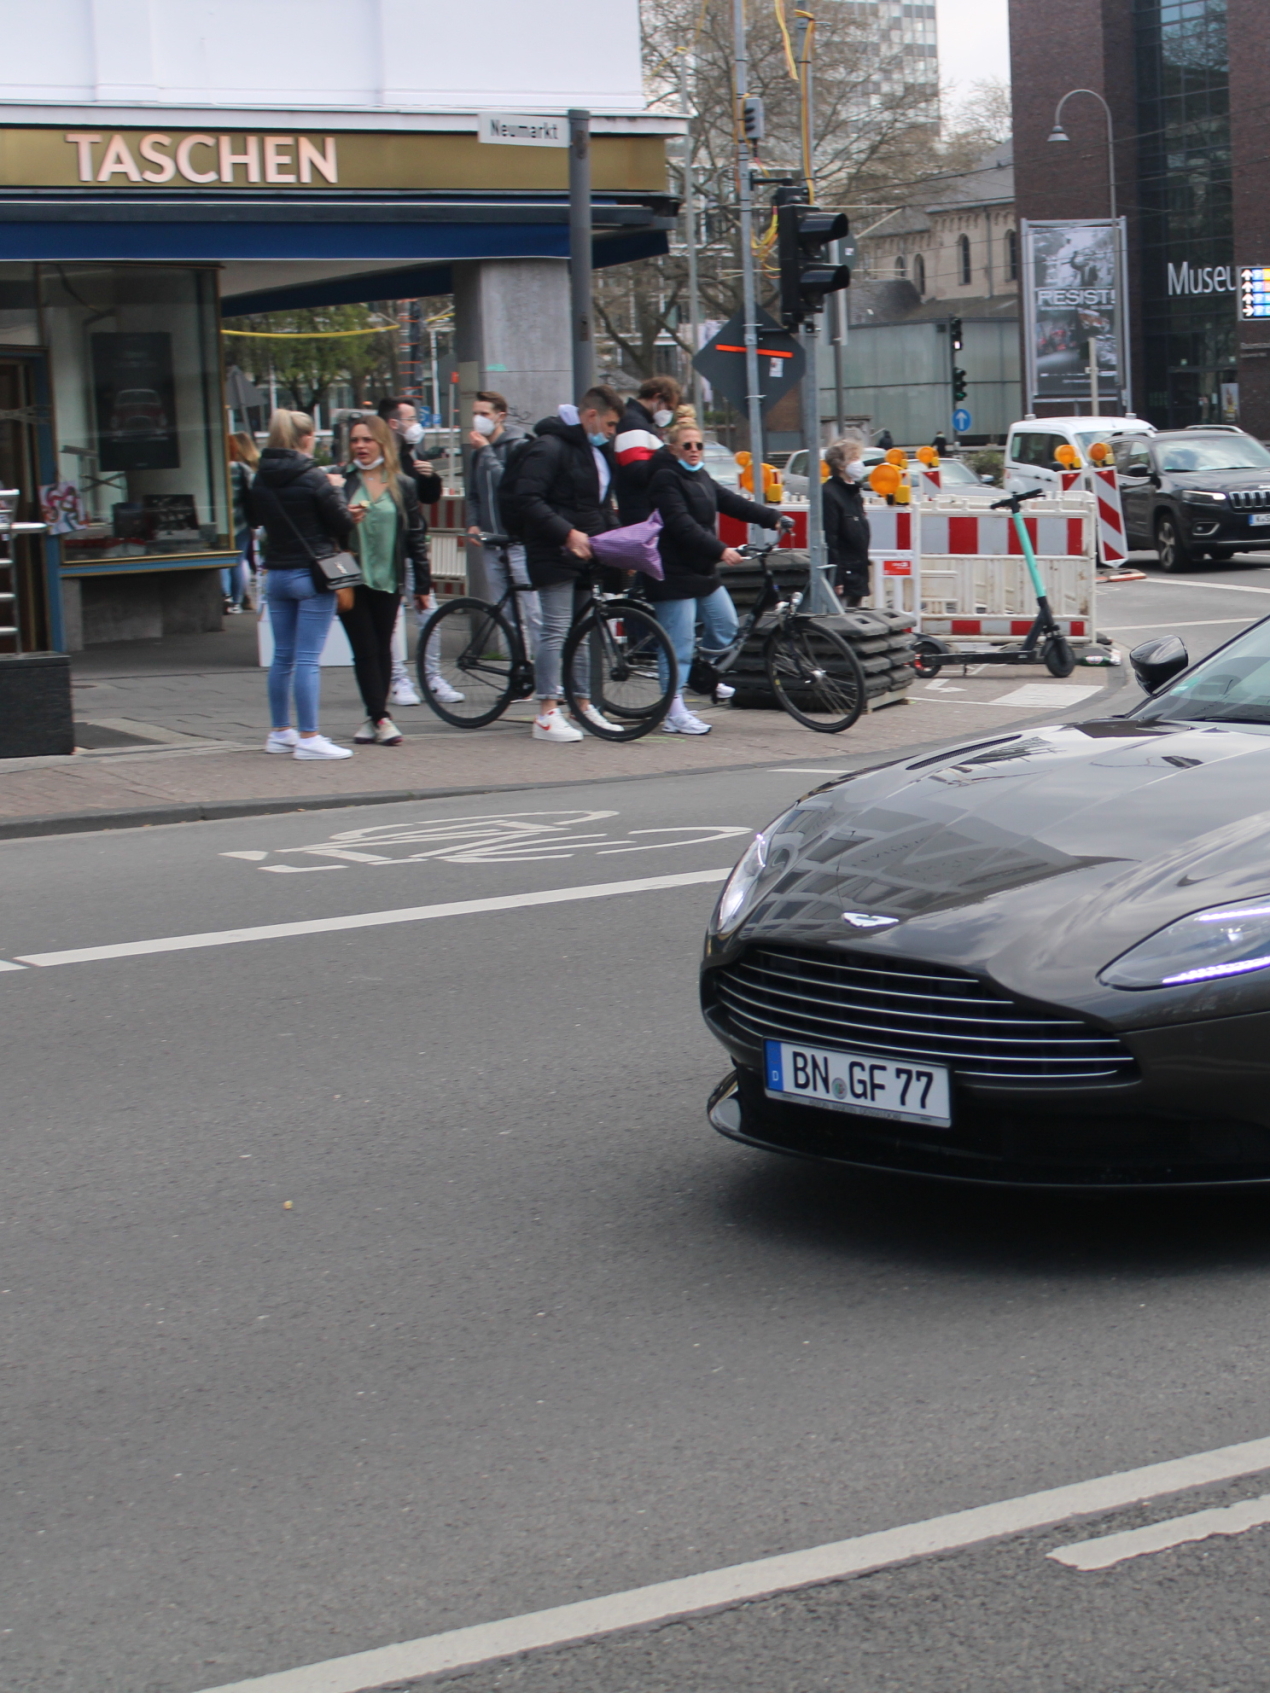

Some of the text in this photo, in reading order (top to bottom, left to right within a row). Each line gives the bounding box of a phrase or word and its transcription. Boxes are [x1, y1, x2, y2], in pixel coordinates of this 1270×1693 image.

[490, 119, 559, 139] Neumarkt
[65, 133, 338, 184] TASCHEN
[1168, 261, 1236, 295] Museu
[1038, 289, 1116, 305] RESIST!
[792, 1051, 830, 1094] BN
[849, 1061, 887, 1102] GF
[895, 1067, 933, 1109] 77
